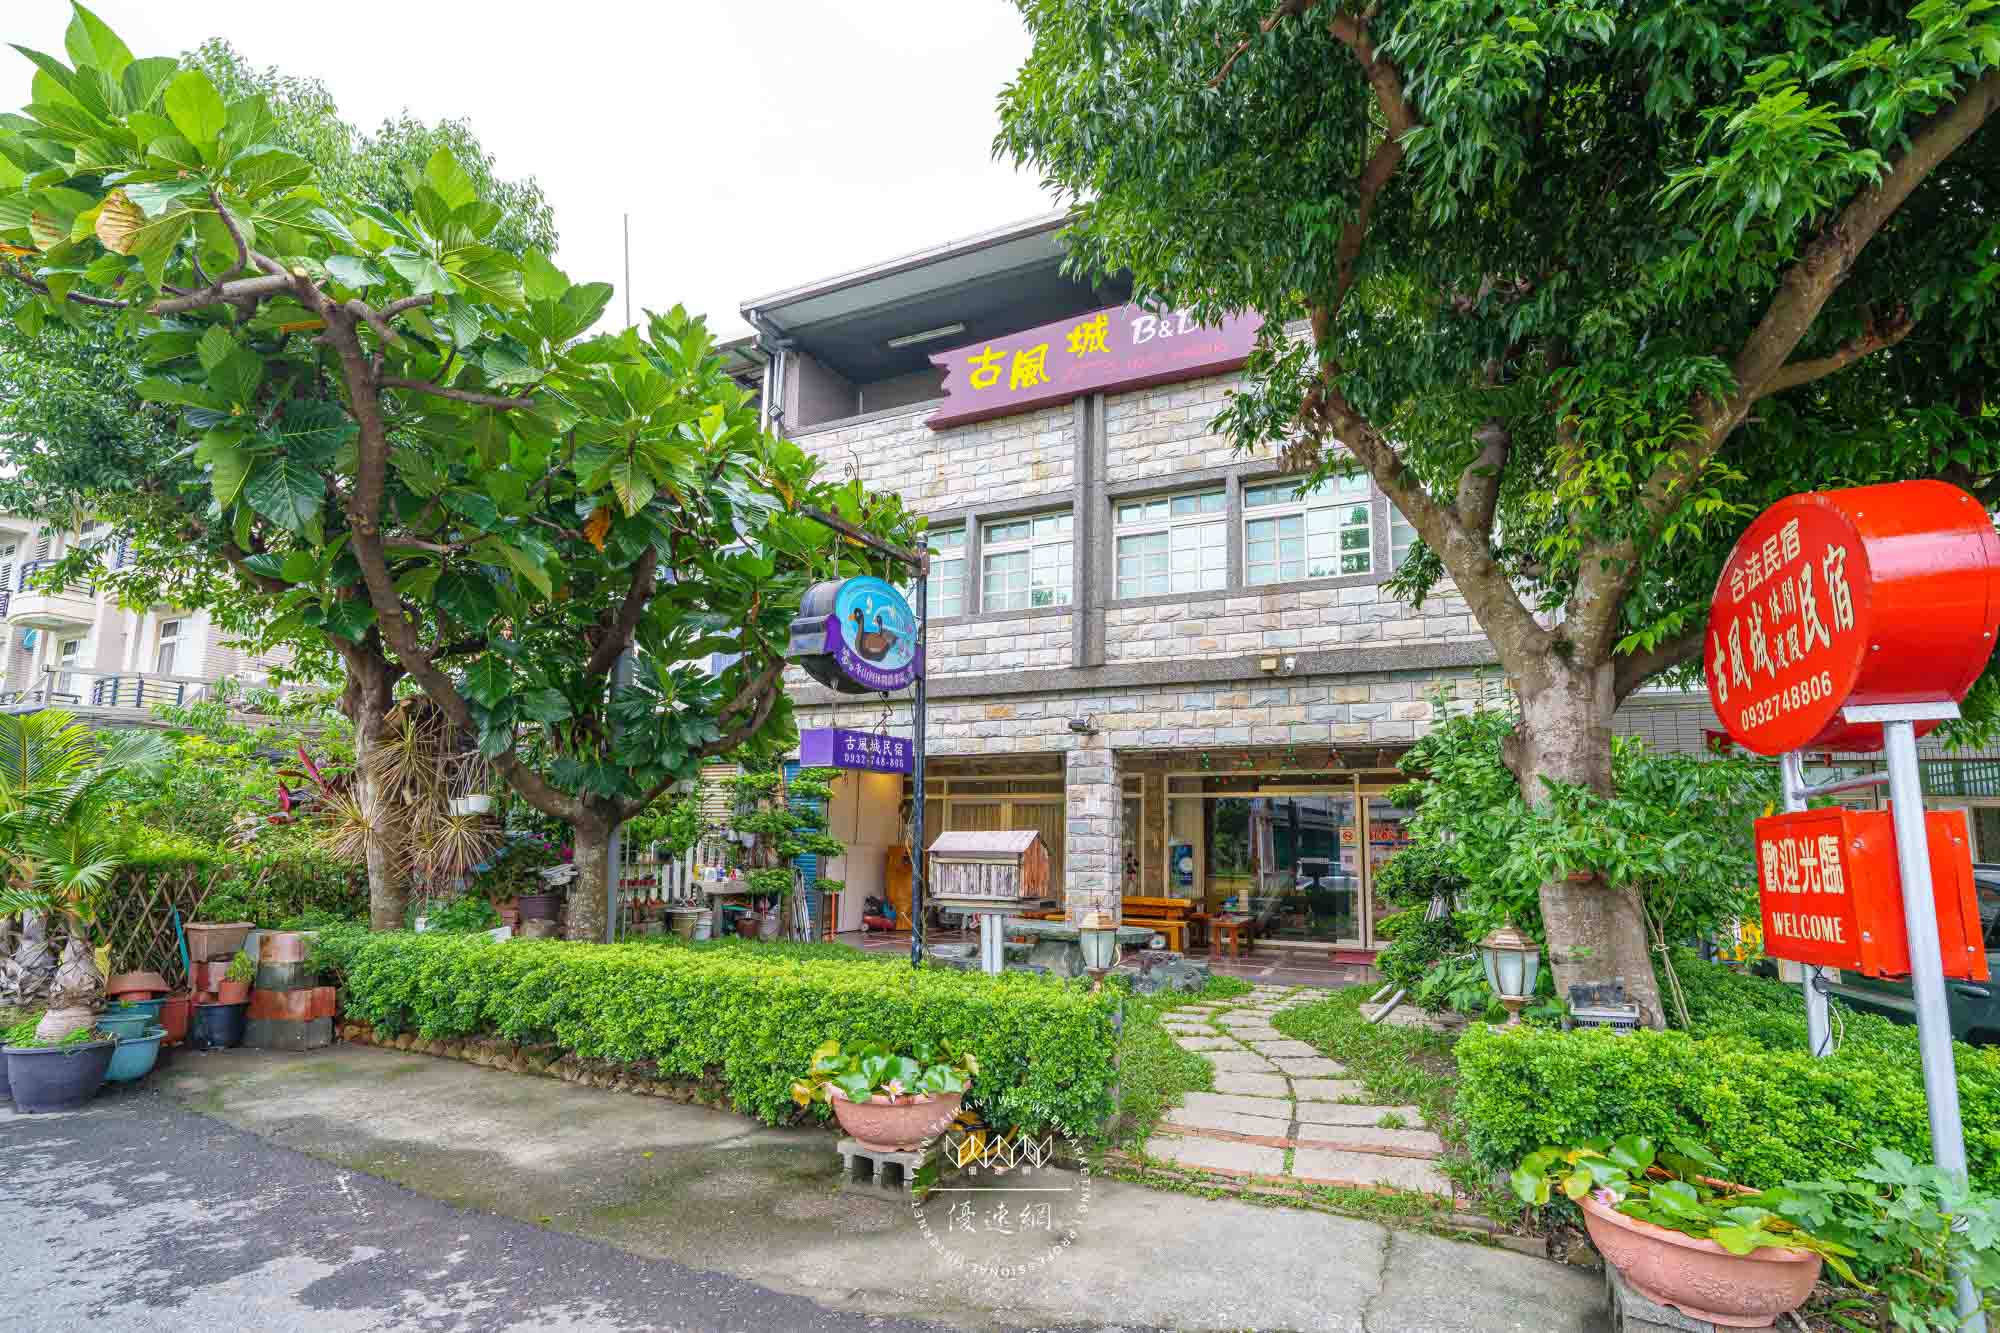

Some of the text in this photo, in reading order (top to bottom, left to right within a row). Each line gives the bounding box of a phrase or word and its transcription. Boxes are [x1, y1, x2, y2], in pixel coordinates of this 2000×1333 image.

[967, 313, 1112, 392] 古風城
[1730, 517, 1801, 604] 合法民宿
[1713, 601, 1776, 704] 古風城
[1774, 624, 1804, 669] 渡假
[1799, 543, 1854, 653] 民宿
[1741, 671, 1832, 731] 0932748806
[843, 735, 904, 756] 古風城民宿
[1761, 835, 1845, 896] 歡迎光臨
[1772, 911, 1848, 944] WELCOME
